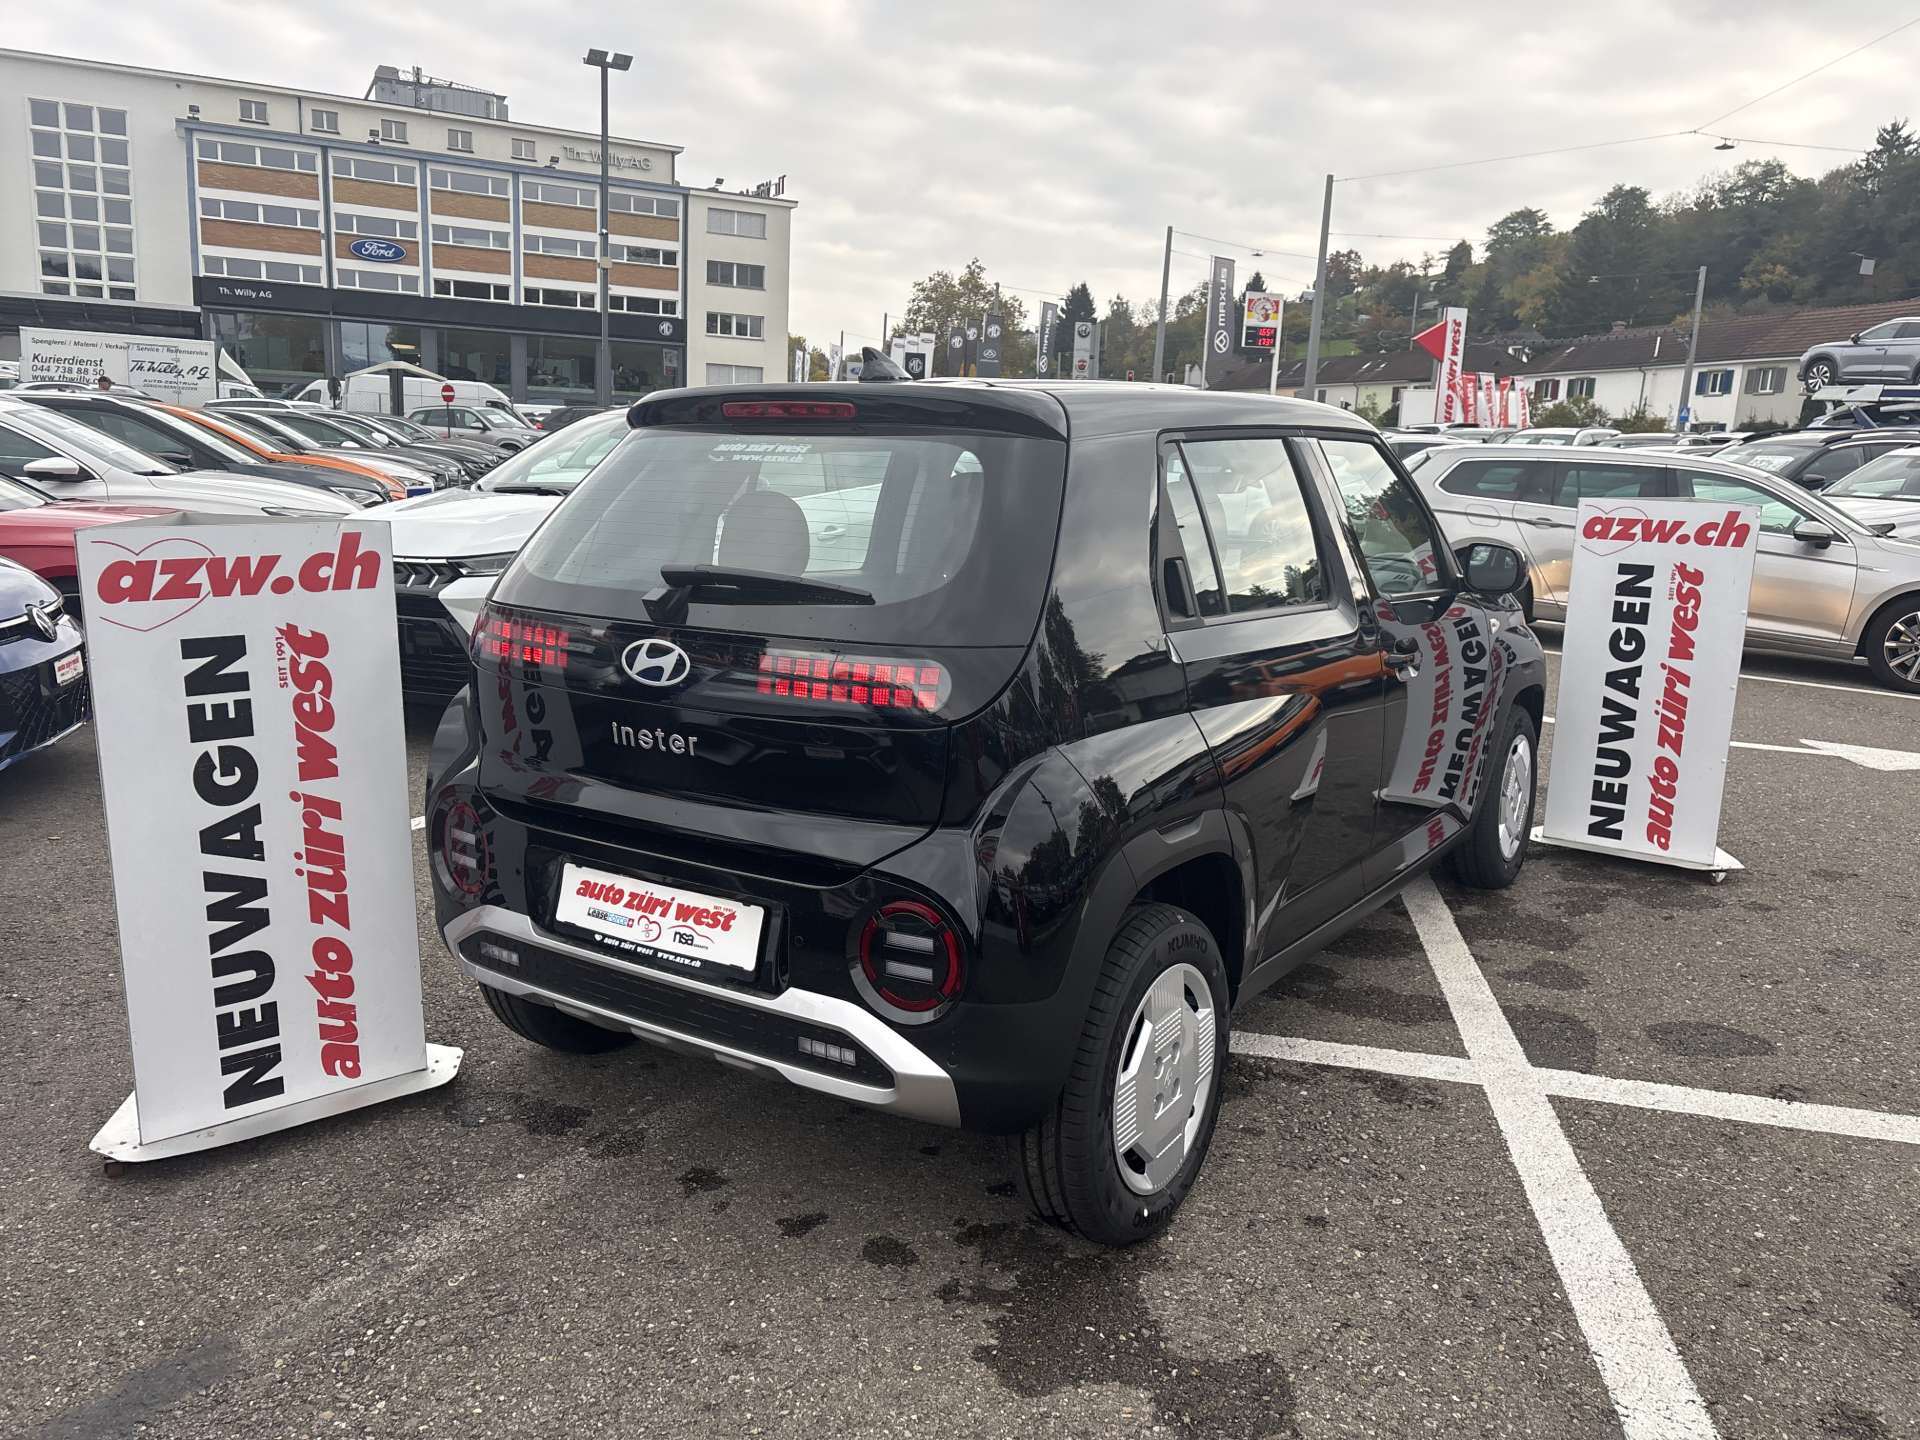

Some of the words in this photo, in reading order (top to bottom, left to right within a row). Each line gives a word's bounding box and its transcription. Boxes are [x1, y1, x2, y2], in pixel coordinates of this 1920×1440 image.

[630, 156, 652, 170] AG
[362, 241, 394, 257] Ford
[218, 286, 232, 295] Th.
[234, 288, 257, 298] Willy
[259, 290, 272, 298] AG
[659, 321, 673, 335] MG
[31, 364, 51, 372] 044
[54, 365, 73, 374] 738
[76, 367, 89, 376] 88
[92, 368, 105, 377] 50
[32, 352, 104, 367] Kurierdienst
[1582, 510, 1751, 549] azw.ch
[97, 532, 381, 604] azw.ch
[1667, 561, 1704, 661] west
[275, 635, 286, 664] 1991
[278, 665, 289, 689] SEIT
[275, 622, 339, 782] west
[1587, 562, 1655, 841] NEUWAGEN
[1654, 662, 1691, 758] züri
[611, 721, 698, 757] inster
[1646, 756, 1680, 851] auto
[180, 634, 285, 1110] NEUWAGEN
[289, 790, 351, 931] züri
[576, 879, 624, 906] auto
[623, 891, 676, 918] züri
[675, 903, 737, 932] west
[673, 931, 695, 946] nsa
[1167, 933, 1208, 954] KUMHO
[304, 936, 362, 1079] auto
